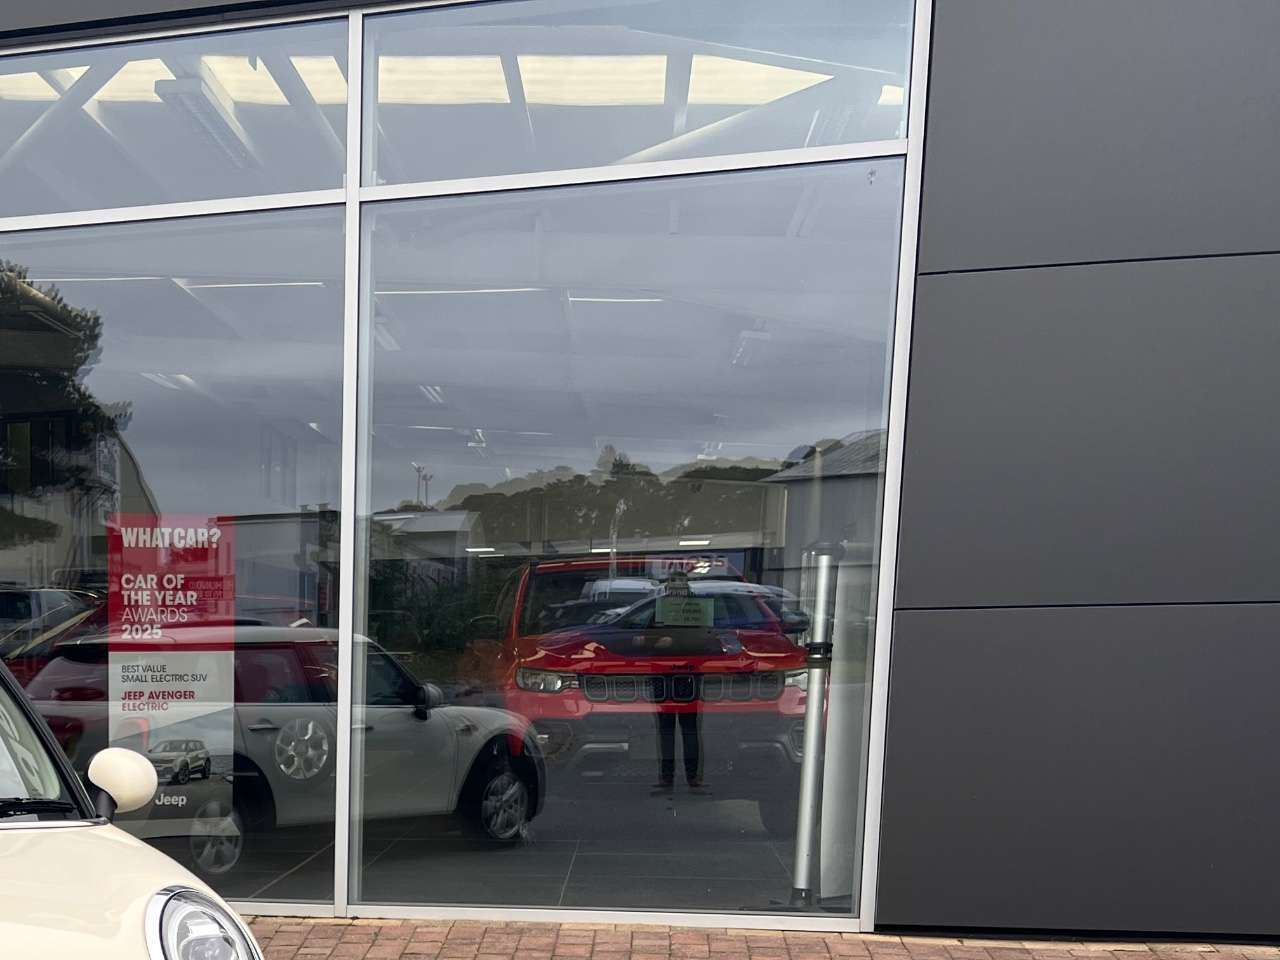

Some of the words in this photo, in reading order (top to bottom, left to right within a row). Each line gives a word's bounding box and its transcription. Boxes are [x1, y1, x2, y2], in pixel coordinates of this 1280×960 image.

[120, 573, 158, 589] CAR
[163, 573, 185, 589] OF
[120, 590, 151, 606] THE
[155, 590, 198, 606] YEAR
[121, 606, 189, 623] AWARDS
[121, 623, 162, 640] 2025
[121, 664, 140, 674] BEST
[141, 664, 167, 673] VALUE
[121, 674, 148, 683] SMALL
[150, 673, 189, 683] ELECTRIC
[190, 672, 207, 682] SUV
[121, 690, 145, 701] JEEP
[147, 689, 196, 701] AVENGER
[121, 701, 169, 712] ELECTRIC
[154, 793, 187, 807] Jeep
